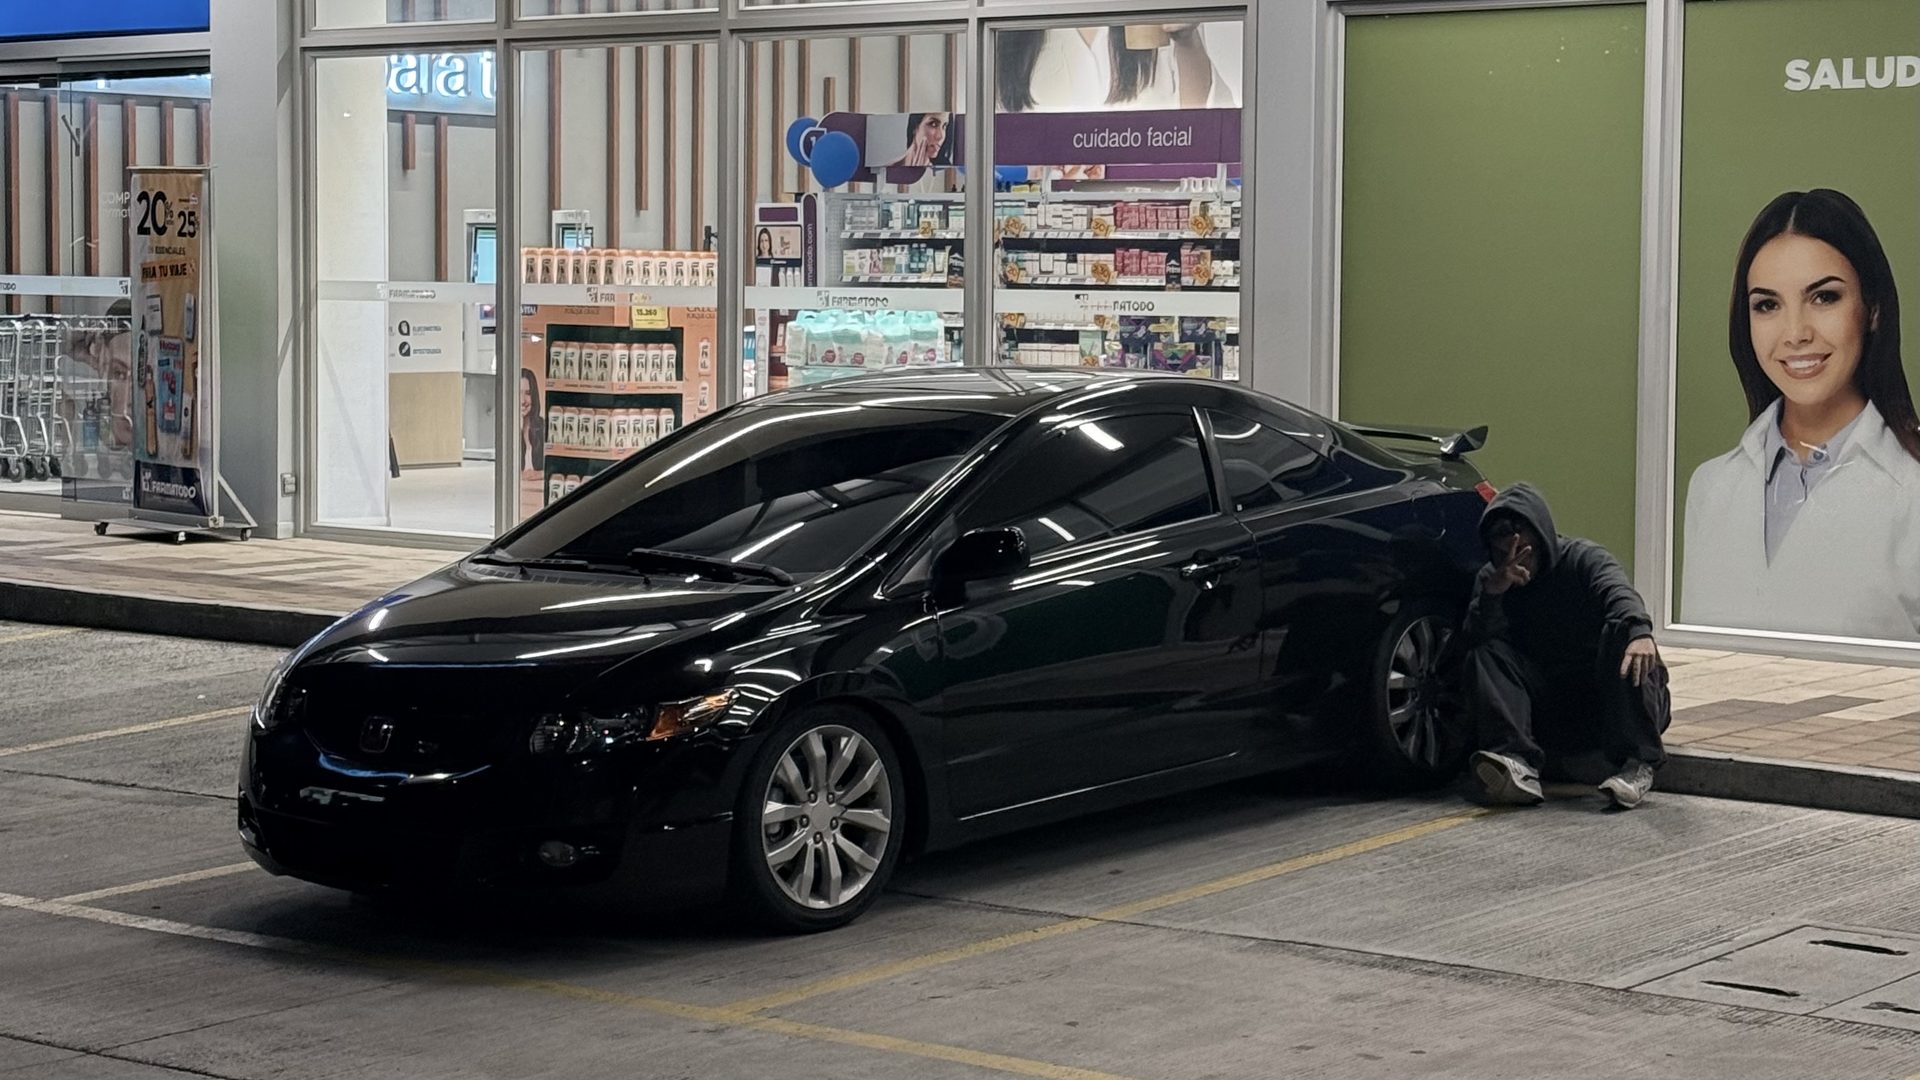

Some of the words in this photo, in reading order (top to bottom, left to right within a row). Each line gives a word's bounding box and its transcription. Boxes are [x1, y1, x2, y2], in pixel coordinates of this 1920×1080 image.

[479, 51, 496, 99] t
[1784, 55, 1920, 91] SALUD
[1073, 128, 1141, 148] cuidado
[1147, 125, 1192, 147] facial
[159, 265, 168, 277] TU
[152, 481, 196, 498] FARMATODO
